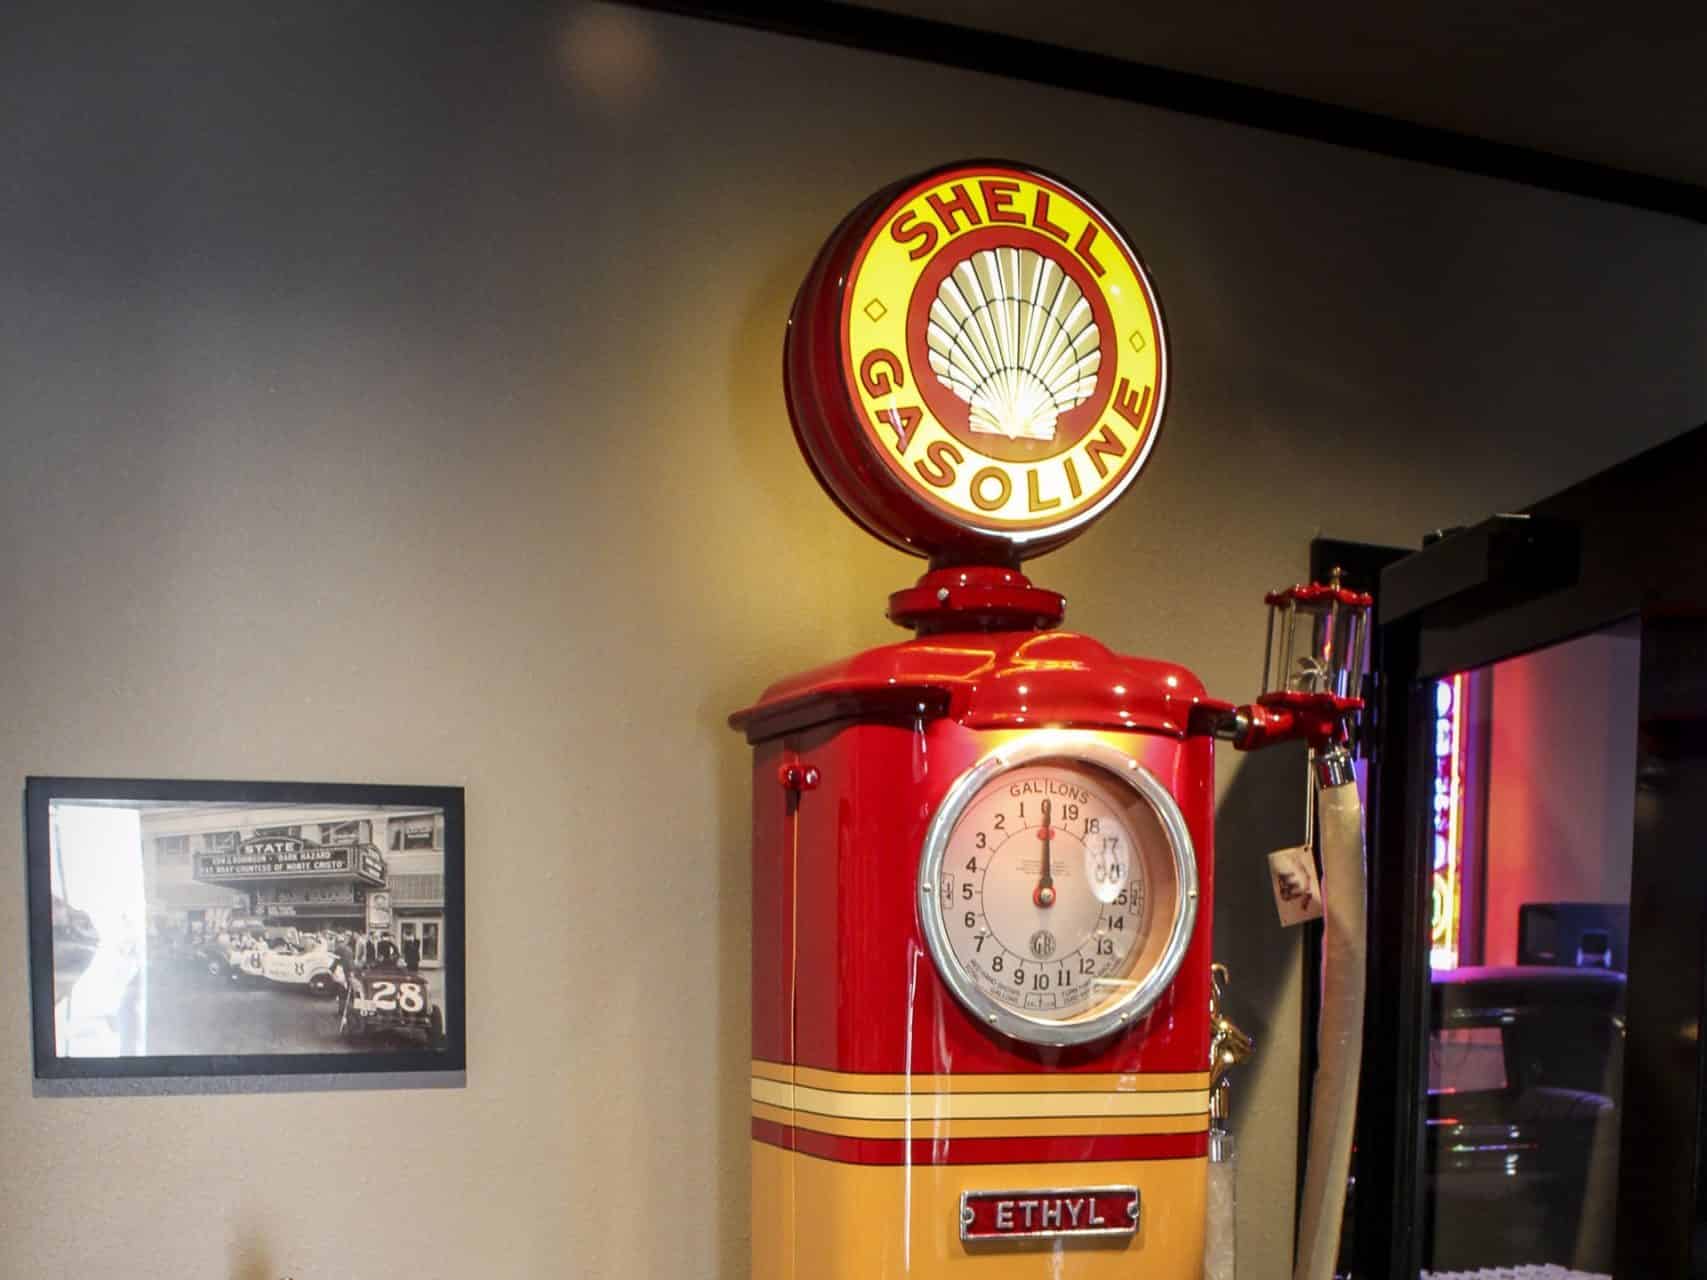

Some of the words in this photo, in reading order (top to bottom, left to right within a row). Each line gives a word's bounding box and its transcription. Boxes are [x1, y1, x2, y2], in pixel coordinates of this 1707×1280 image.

[890, 180, 1106, 278] SHELL
[860, 348, 1151, 513] GASOLINE
[1010, 781, 1089, 804] GALLONS
[1018, 802, 1024, 818] 1
[1062, 804, 1079, 820] 19
[994, 814, 1005, 830] 2
[1084, 818, 1100, 834] 18
[244, 842, 295, 855] STATE
[975, 832, 986, 848] 3
[966, 856, 977, 872] 4
[962, 883, 973, 900] 5
[1112, 889, 1128, 905] 5
[964, 911, 976, 928] 6
[1108, 916, 1124, 931] 14
[974, 935, 984, 952] 7
[1096, 938, 1113, 955] 13
[991, 956, 1003, 972] 8
[1079, 958, 1095, 975] 12
[1014, 968, 1025, 985] 9
[1032, 973, 1049, 991] 10
[1057, 969, 1071, 987] 11
[372, 981, 424, 1012] 28
[996, 1198, 1104, 1229] ETHYL
